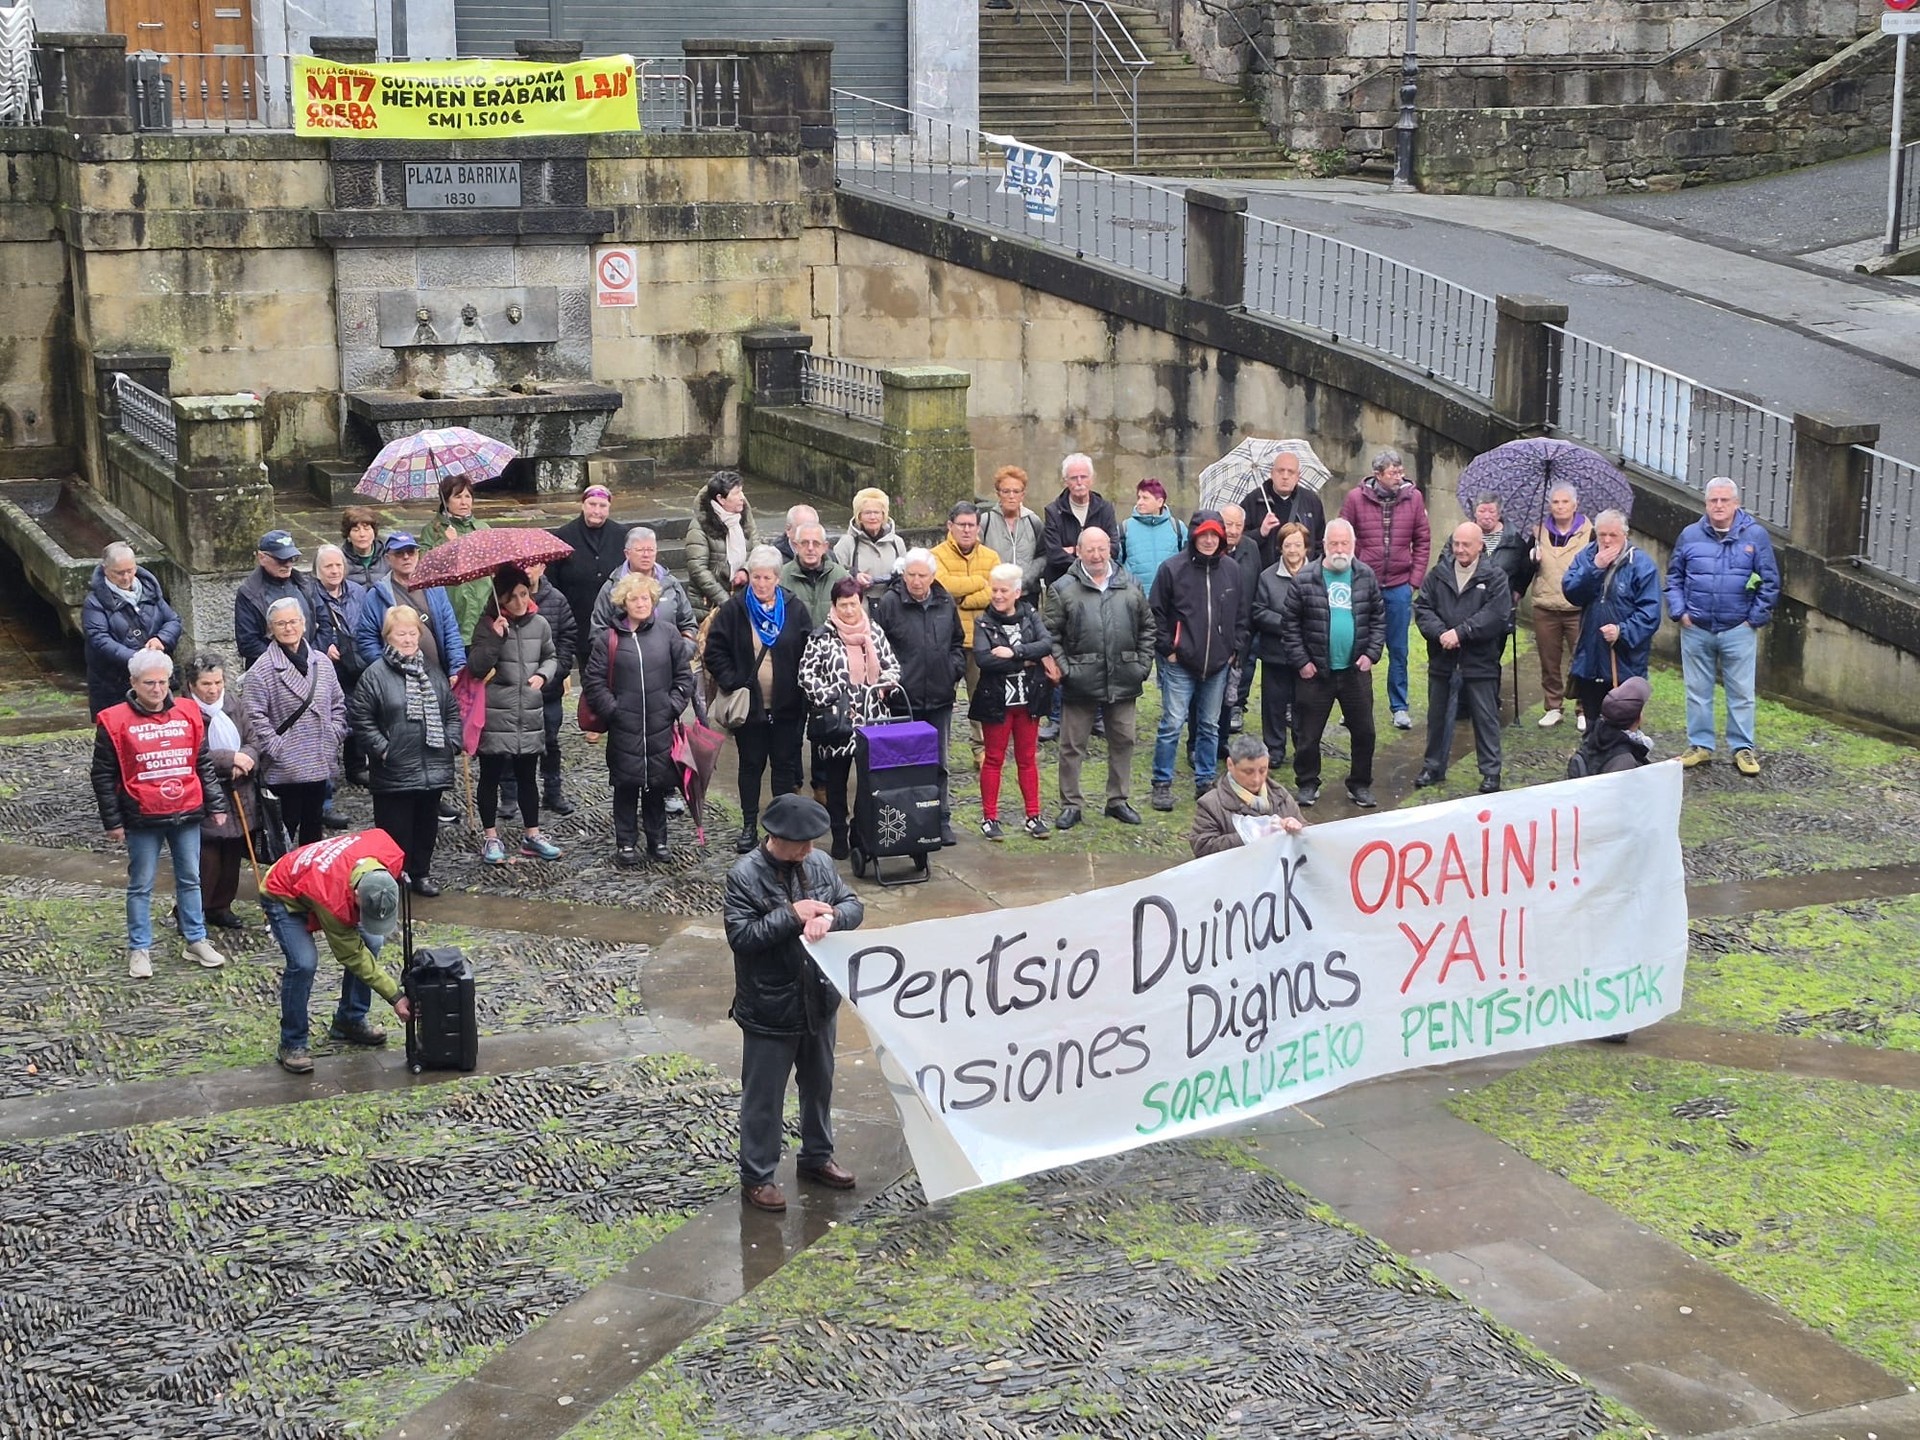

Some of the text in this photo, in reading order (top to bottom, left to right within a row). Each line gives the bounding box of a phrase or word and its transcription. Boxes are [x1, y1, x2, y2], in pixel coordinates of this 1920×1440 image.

[307, 75, 377, 102] M17
[381, 69, 565, 90] GUTXIENEKO SOLDATA
[381, 85, 566, 107] HEMEN ERABAKI
[306, 102, 377, 119] GREBA
[427, 110, 525, 130] SMI 1.500€
[306, 117, 377, 130] OROKORRA
[408, 166, 518, 184] PLAZA BARRIXA
[444, 192, 476, 205] 1830
[1398, 906, 1527, 996] YA!!
[847, 932, 1100, 1024] Pentsio
[1187, 951, 1361, 1053] Dignas
[1136, 1020, 1364, 1135] SORALUZEKO
